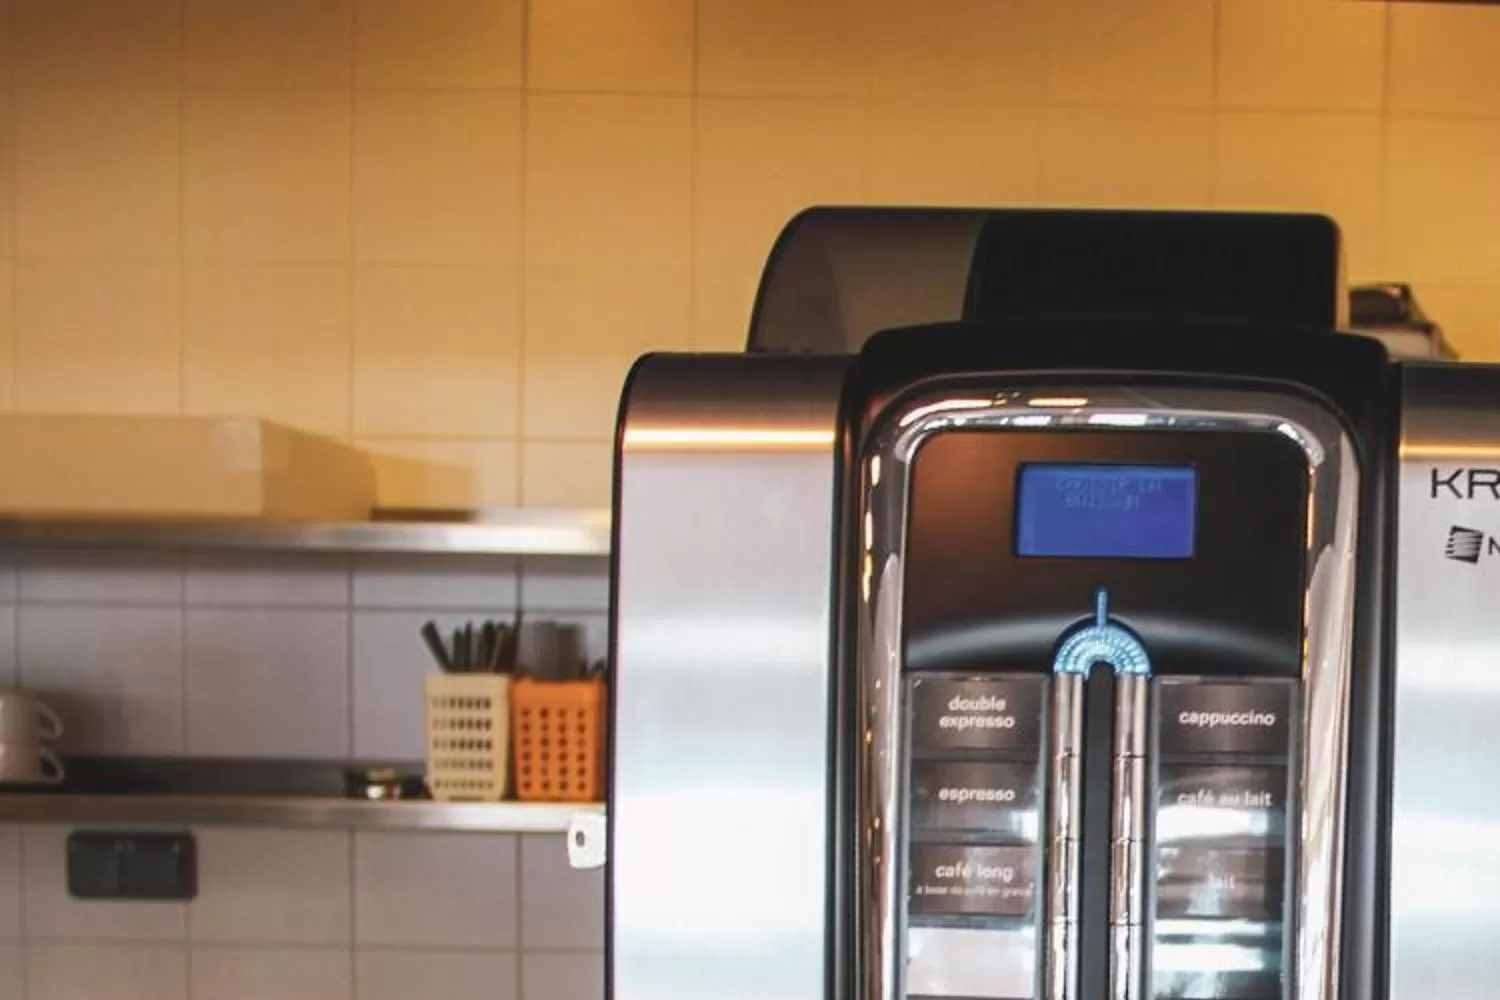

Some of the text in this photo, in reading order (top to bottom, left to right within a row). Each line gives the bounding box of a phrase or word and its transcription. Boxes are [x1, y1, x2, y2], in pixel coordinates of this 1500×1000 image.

[947, 695, 1007, 711] double
[939, 715, 1016, 732] expresso
[1178, 709, 1276, 728] cappuccino
[938, 788, 1016, 804] espresso
[1177, 788, 1273, 807] café au lait
[934, 860, 1014, 884] café long
